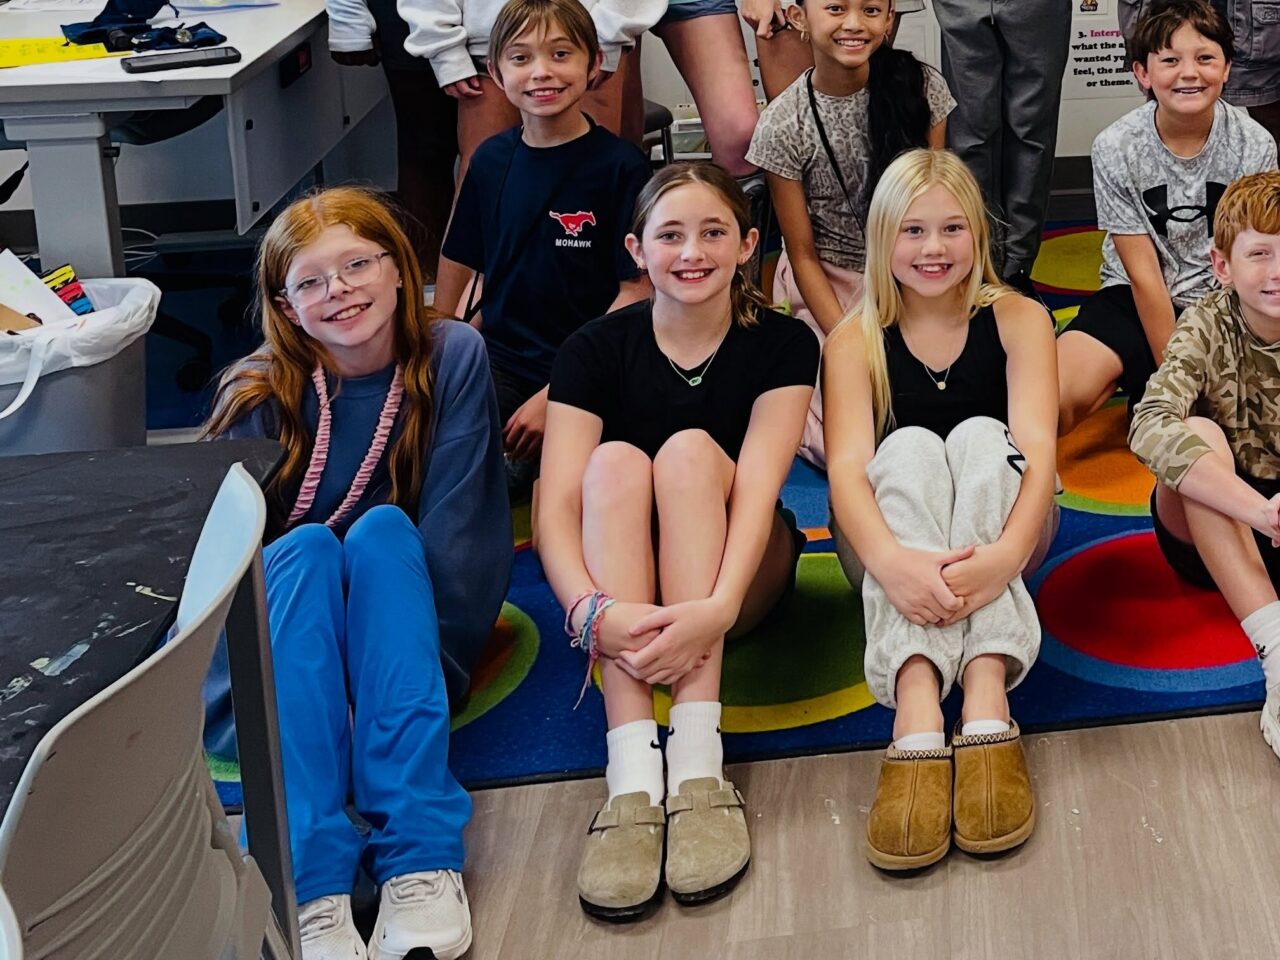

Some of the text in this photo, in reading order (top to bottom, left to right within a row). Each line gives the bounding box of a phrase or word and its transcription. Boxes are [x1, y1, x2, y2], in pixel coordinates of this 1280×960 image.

[1078, 30, 1121, 39] 3. Interp
[1074, 54, 1111, 62] wanted
[1074, 68, 1094, 76] feel,
[1100, 79, 1133, 87] theme.
[555, 238, 592, 248] MOHAWK
